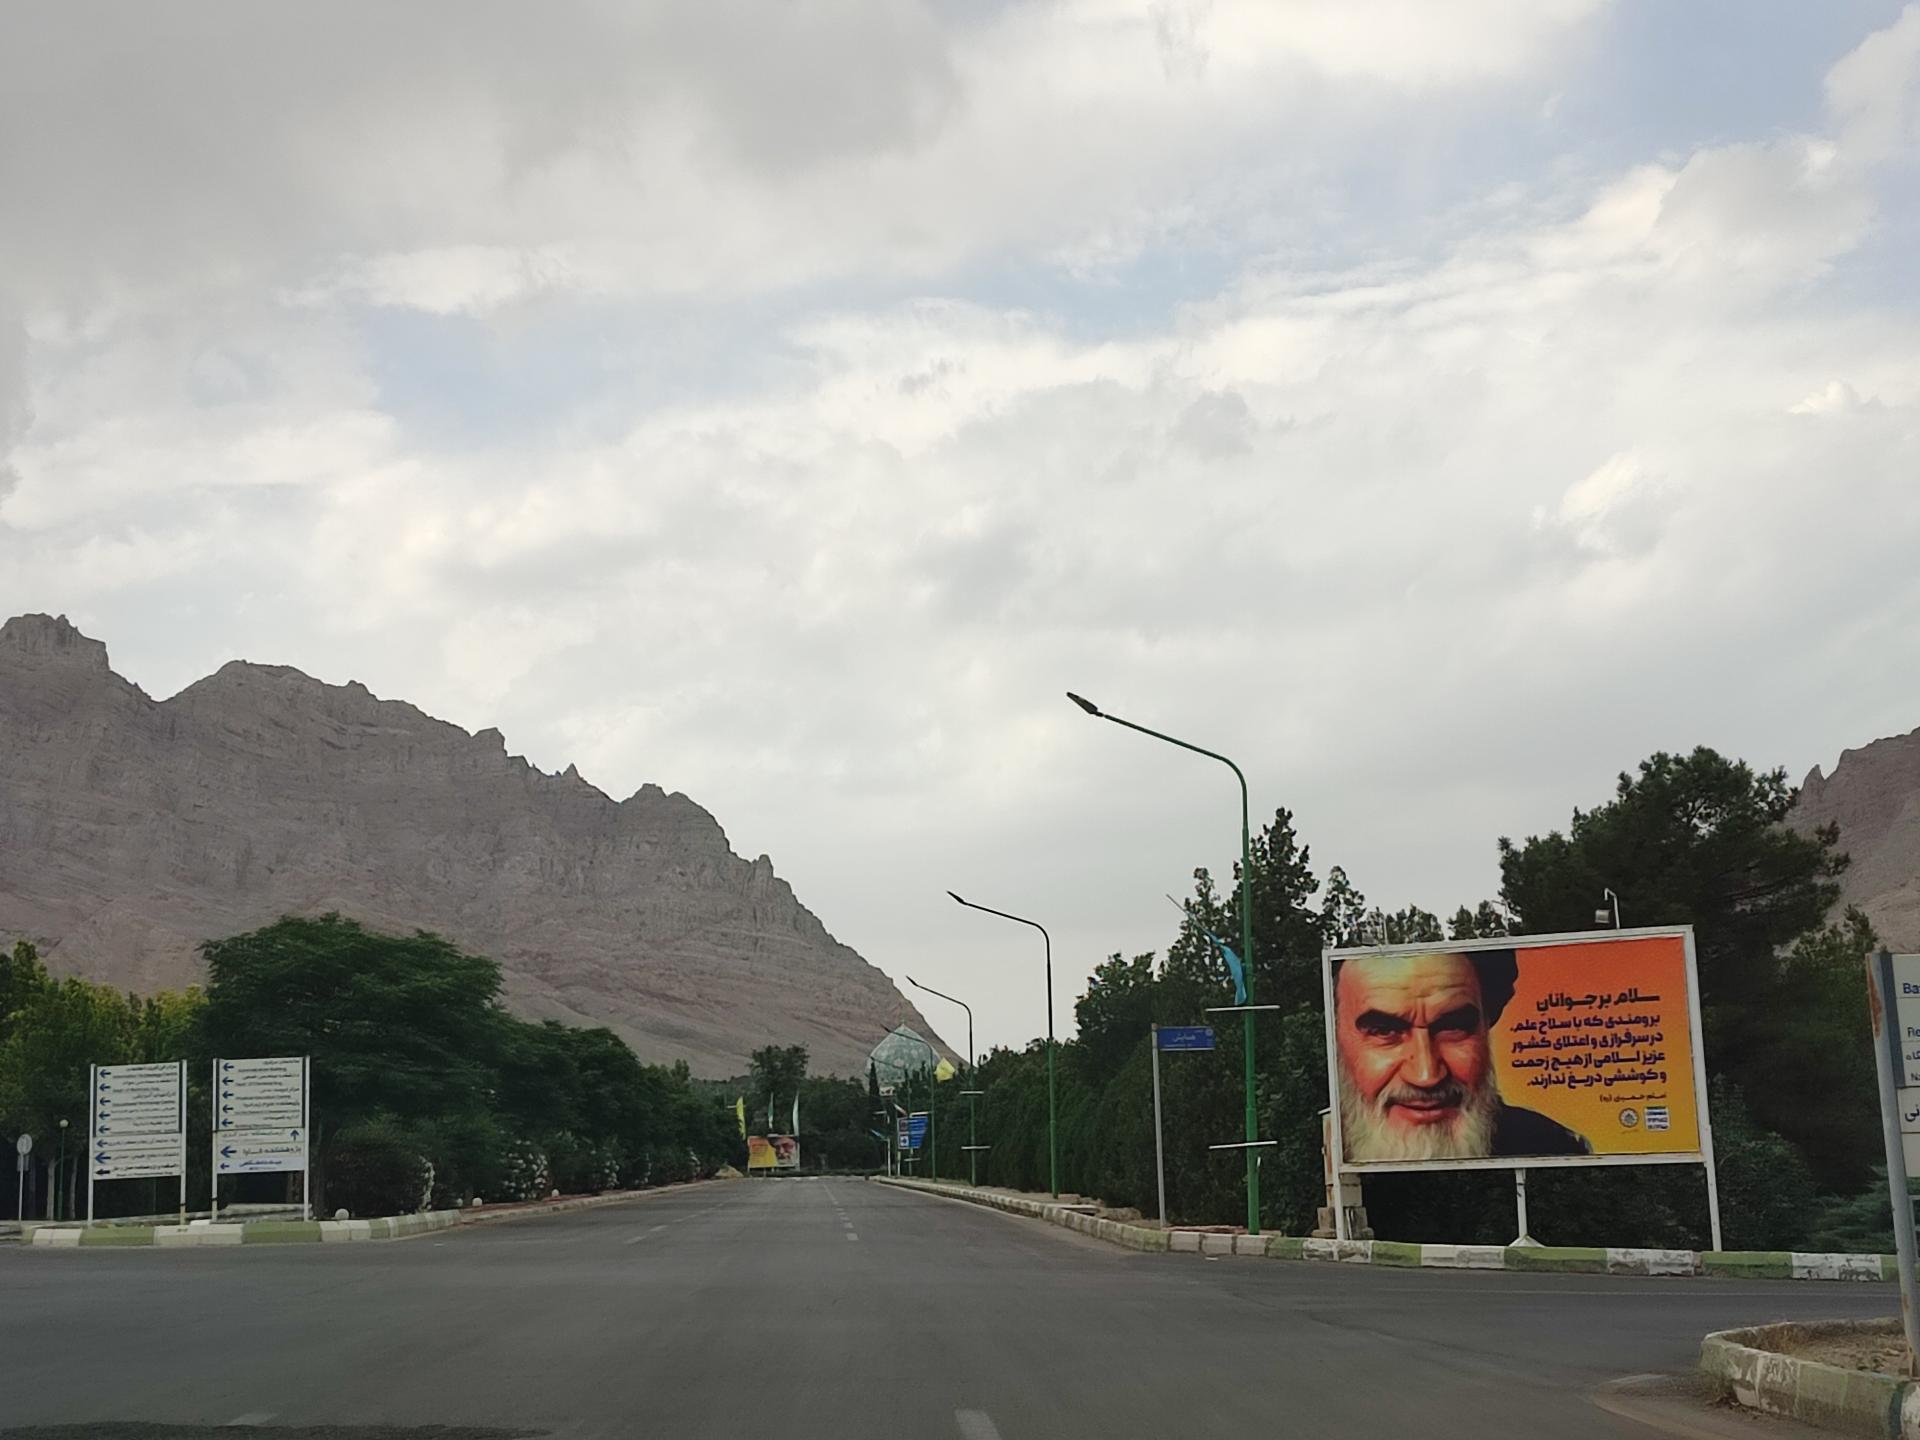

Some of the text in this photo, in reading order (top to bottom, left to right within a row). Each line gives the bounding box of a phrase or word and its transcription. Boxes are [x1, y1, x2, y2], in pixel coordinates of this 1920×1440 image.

[1903, 982, 1920, 994] Ba
[1597, 993, 1612, 1009] بر
[1613, 987, 1660, 1005] سلام
[1538, 1018, 1572, 1035] سلاح
[1572, 1016, 1582, 1031] با
[1584, 1015, 1603, 1026] که
[1605, 1013, 1660, 1028] برومندی
[1511, 1034, 1551, 1053] کشور
[1553, 1034, 1590, 1050] اعتلای
[1649, 1032, 1664, 1046] در
[1511, 1056, 1550, 1070] زحمت
[1551, 1055, 1583, 1071] هیچ
[1583, 1053, 1592, 1068] از
[1642, 1050, 1665, 1065] عزیز
[1567, 1072, 1602, 1088] دریغ
[1604, 1067, 1658, 1086] کوششی
[1659, 1071, 1667, 1083] و
